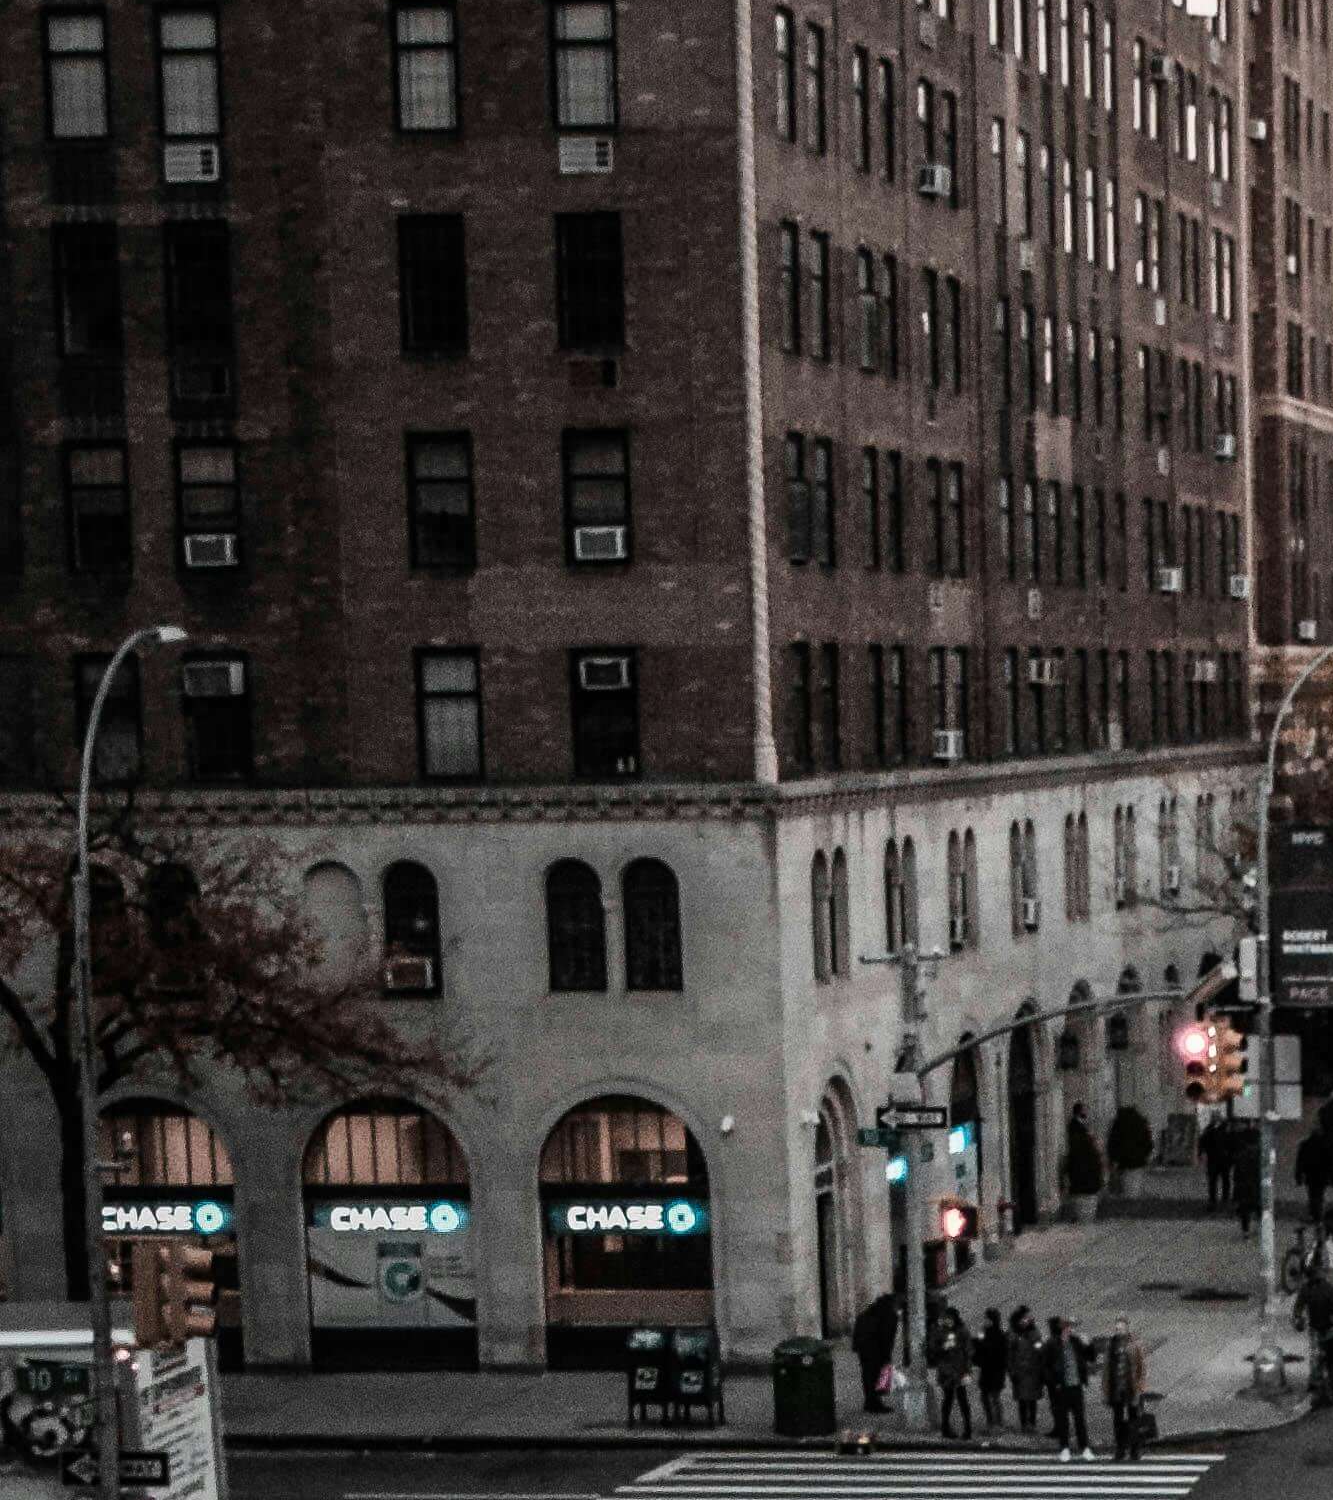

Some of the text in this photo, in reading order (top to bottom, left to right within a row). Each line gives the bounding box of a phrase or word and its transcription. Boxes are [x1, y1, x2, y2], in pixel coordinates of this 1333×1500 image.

[101, 1206, 193, 1231] CHASE
[329, 1205, 427, 1231] CHASE
[566, 1204, 664, 1231] CHASE
[28, 1367, 53, 1392] 10
